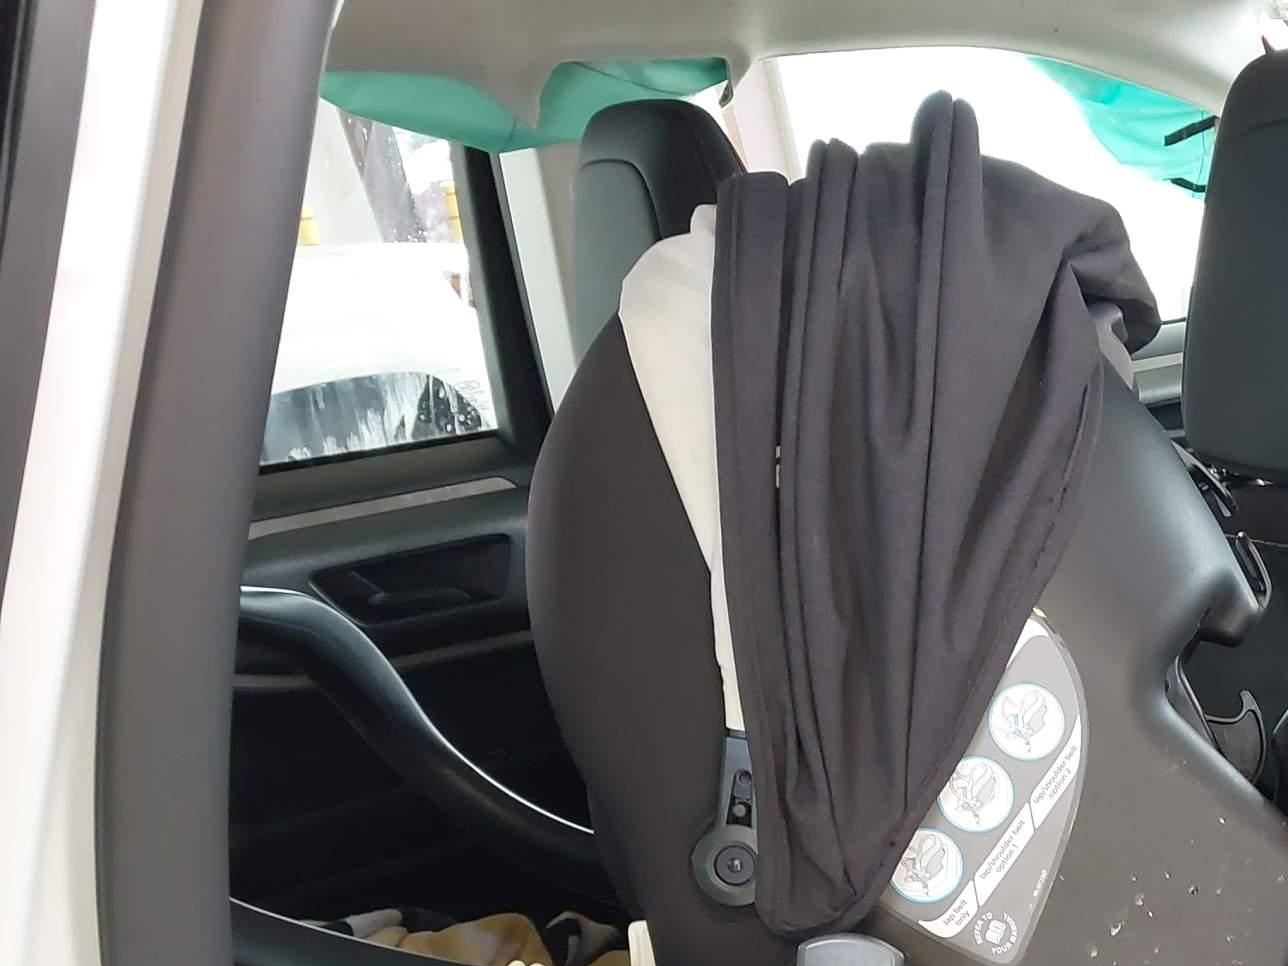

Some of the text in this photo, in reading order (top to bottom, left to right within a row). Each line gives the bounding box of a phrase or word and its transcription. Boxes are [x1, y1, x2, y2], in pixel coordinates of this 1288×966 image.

[1033, 745, 1078, 804] lap/shoulder belt
[1049, 774, 1068, 799] option
[979, 820, 1026, 879] lap/shoulder belt
[996, 849, 1015, 873] option
[943, 900, 968, 926] lap belt
[955, 911, 970, 926] only
[991, 941, 1012, 955] YOUR
